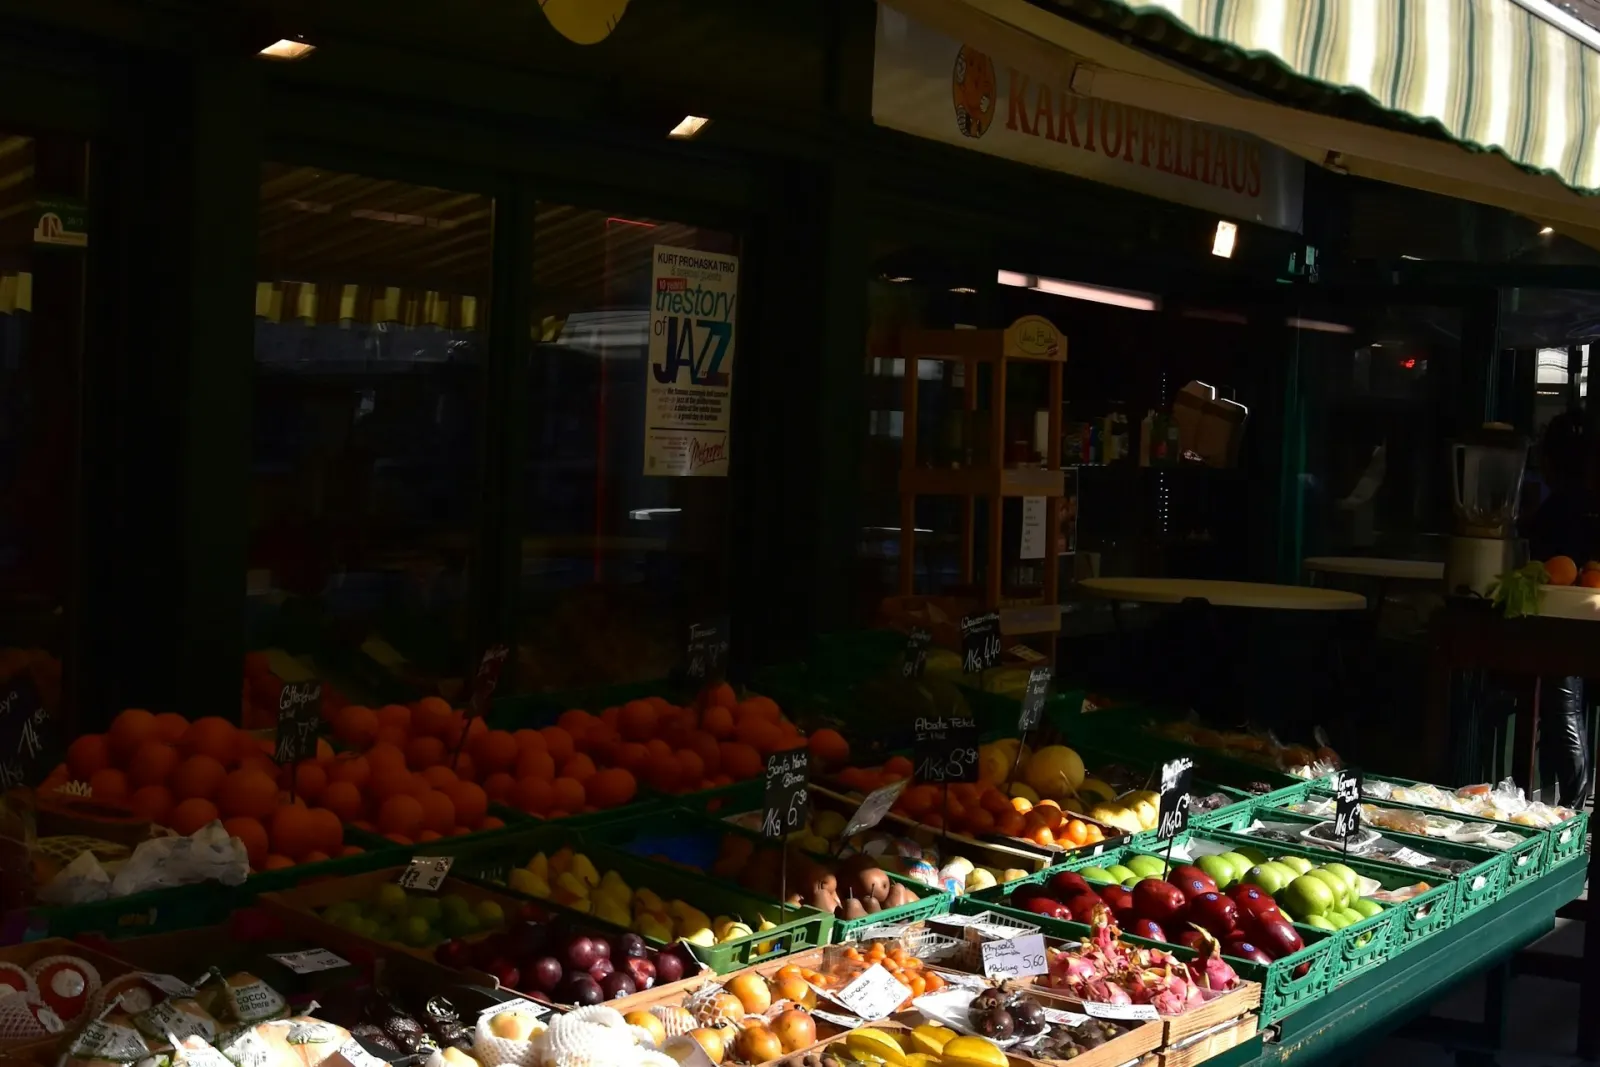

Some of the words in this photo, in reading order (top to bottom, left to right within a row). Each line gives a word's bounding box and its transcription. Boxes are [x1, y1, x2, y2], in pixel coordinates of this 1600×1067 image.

[1006, 70, 1262, 198] KARTOFFELHAUS
[657, 252, 678, 266] KURT
[679, 255, 718, 270] PROHASKA
[718, 261, 736, 273] TRIO
[654, 315, 667, 336] of
[653, 316, 732, 387] JAZZ
[914, 716, 949, 731] Abate
[766, 755, 790, 779] Santa
[1022, 953, 1045, 969] 5,60
[239, 1003, 250, 1013] da
[250, 1001, 270, 1010] bere
